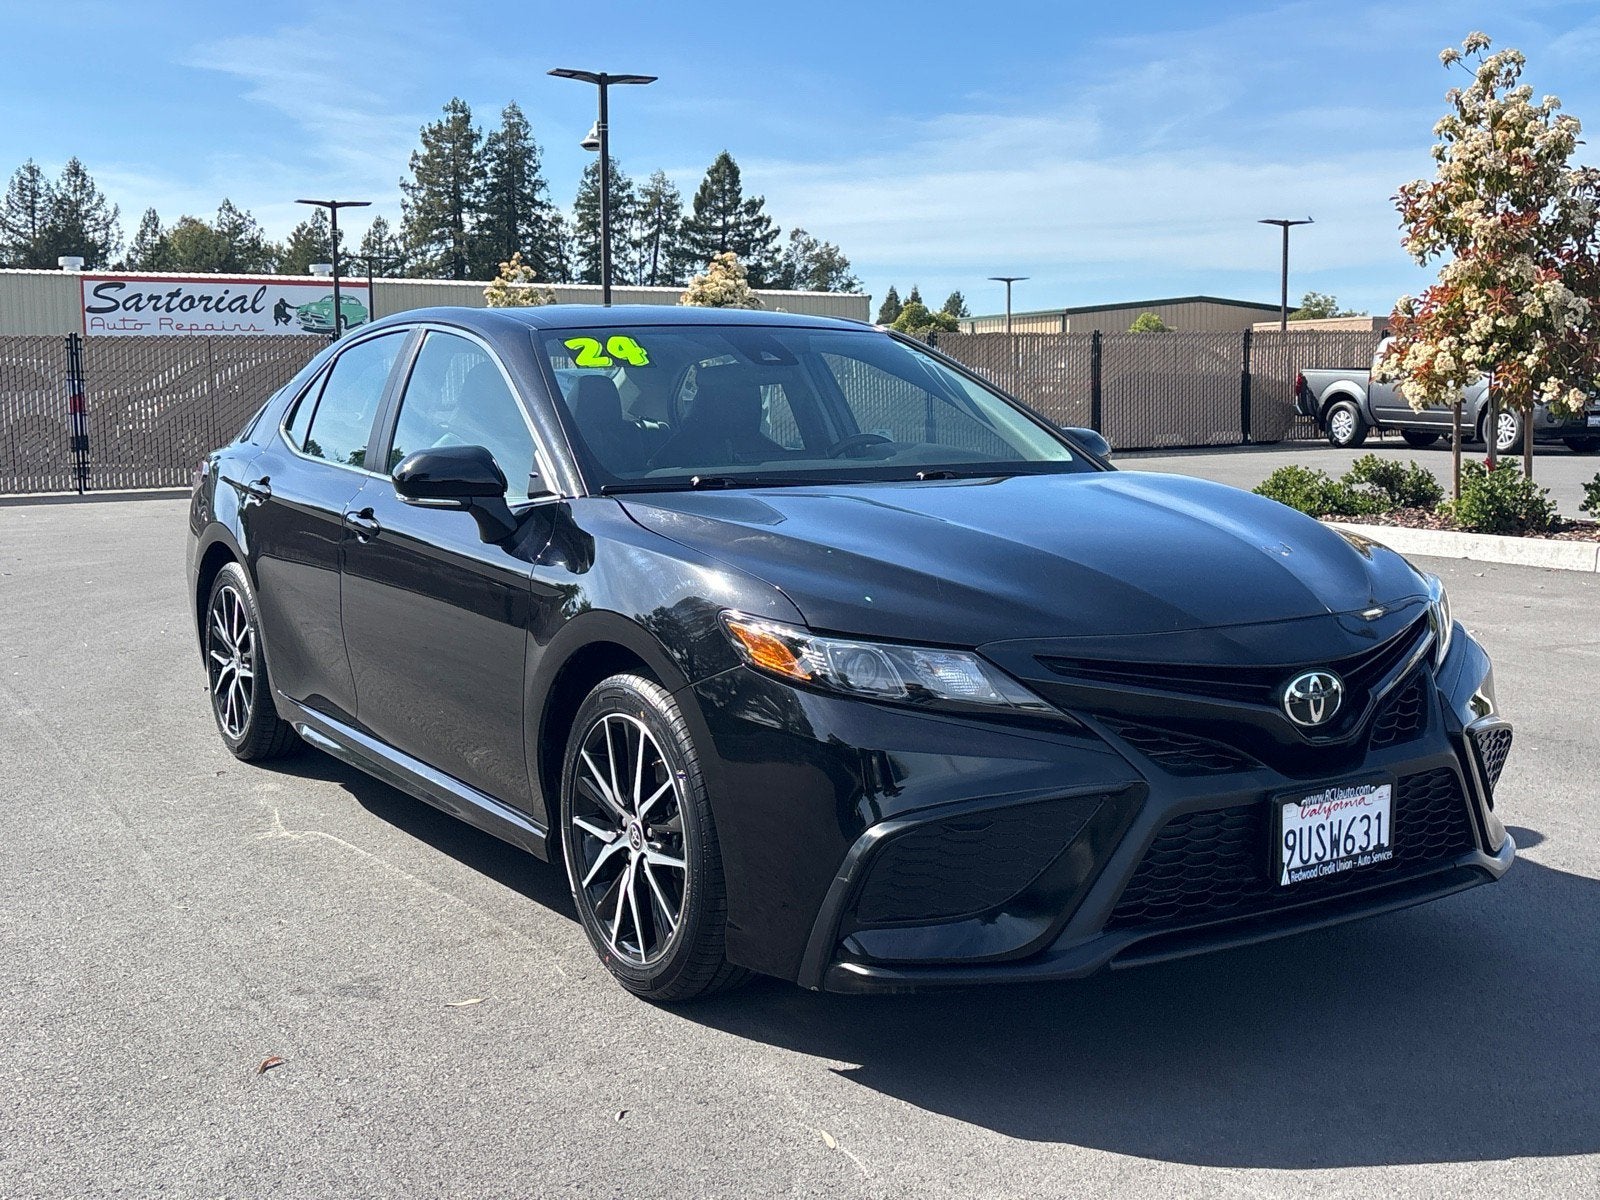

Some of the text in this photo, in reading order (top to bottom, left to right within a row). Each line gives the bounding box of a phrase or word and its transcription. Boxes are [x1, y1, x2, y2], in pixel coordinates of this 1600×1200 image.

[85, 281, 267, 314] Sartorial
[90, 316, 265, 334] Auto Repairs
[564, 336, 650, 367] 24
[1300, 796, 1373, 820] California
[1284, 811, 1382, 870] 9USW631
[1290, 866, 1318, 883] Redwood
[1318, 862, 1336, 877] Credit
[1336, 859, 1353, 872] Union
[1357, 855, 1371, 867] Auto
[1371, 850, 1393, 864] Services
